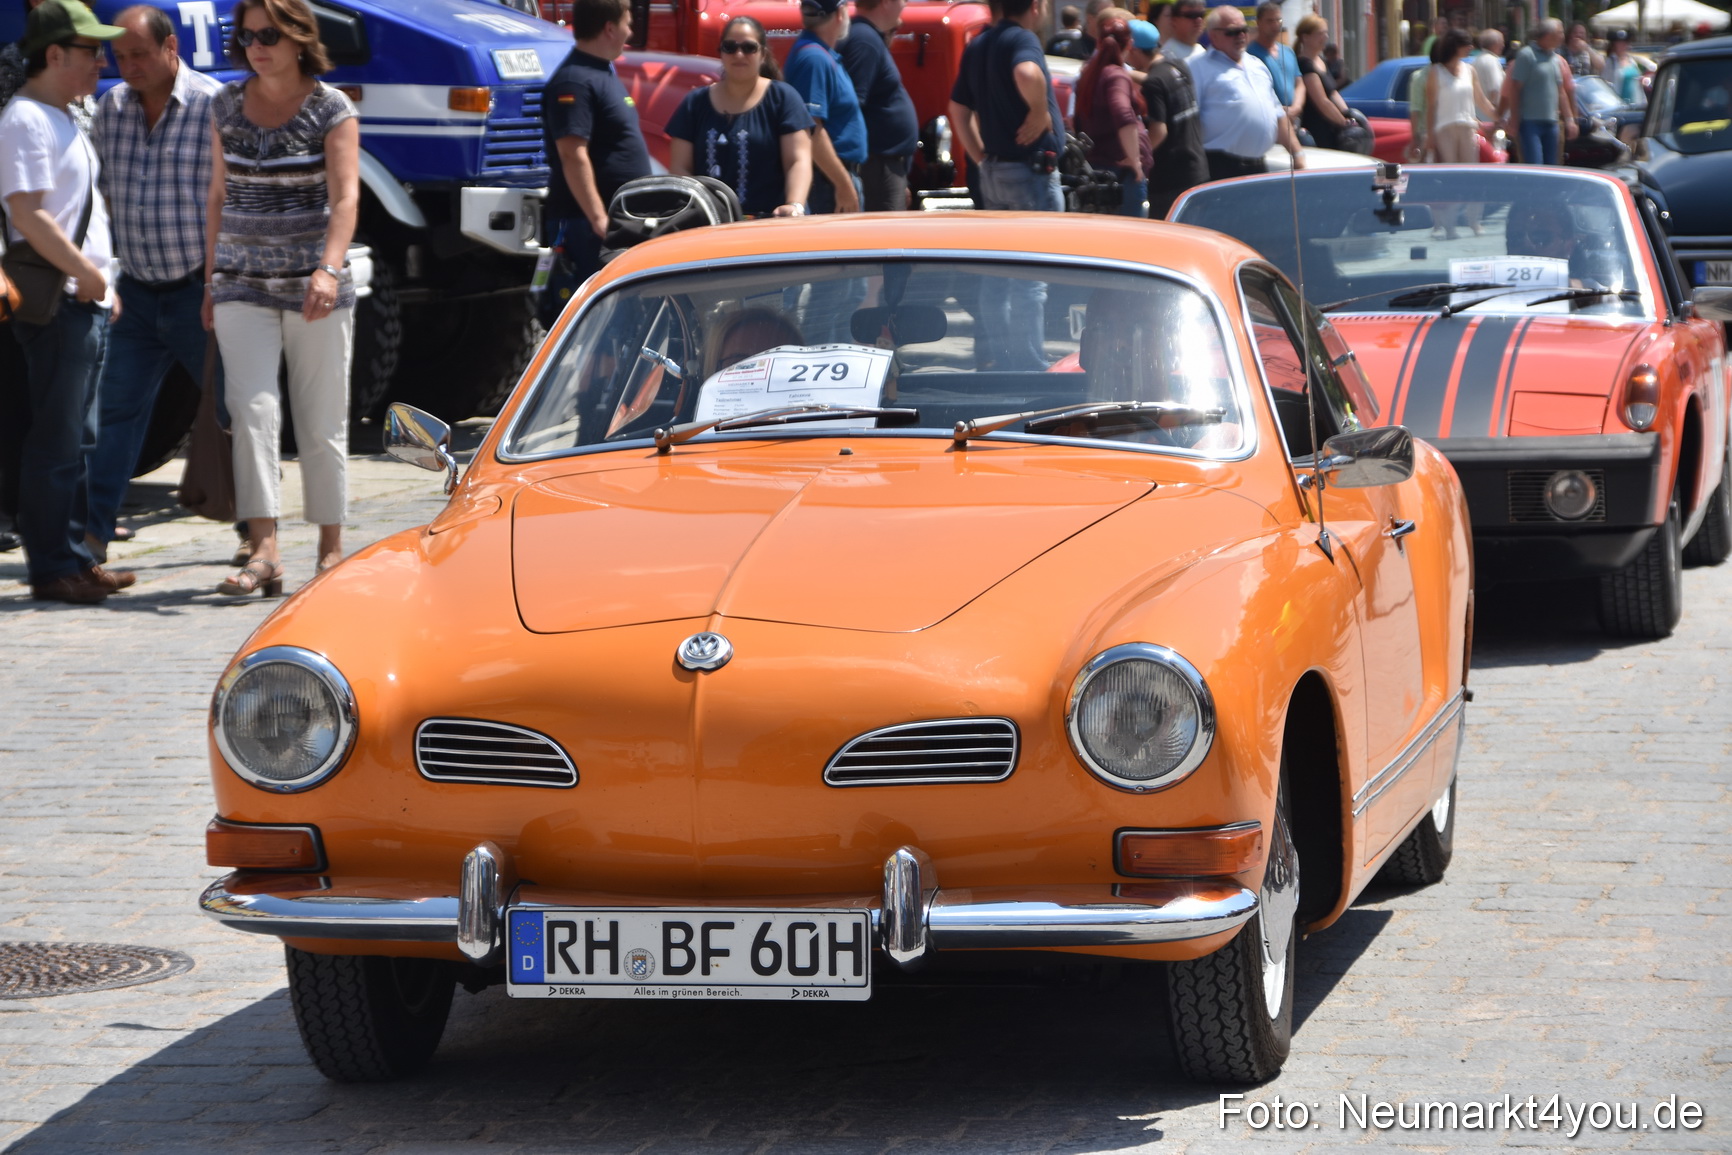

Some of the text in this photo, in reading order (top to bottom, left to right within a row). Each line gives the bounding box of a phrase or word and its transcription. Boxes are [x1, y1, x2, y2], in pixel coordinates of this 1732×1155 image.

[1506, 267, 1544, 281] 287
[1707, 263, 1731, 281] NM
[788, 362, 849, 383] 279
[546, 920, 619, 975] RH
[662, 921, 735, 976] BF
[750, 921, 863, 977] 60H
[522, 955, 534, 970] D
[559, 987, 586, 996] DEKRA
[633, 988, 743, 998] Alles im grünen Bereich.
[802, 989, 830, 998] DEKRA
